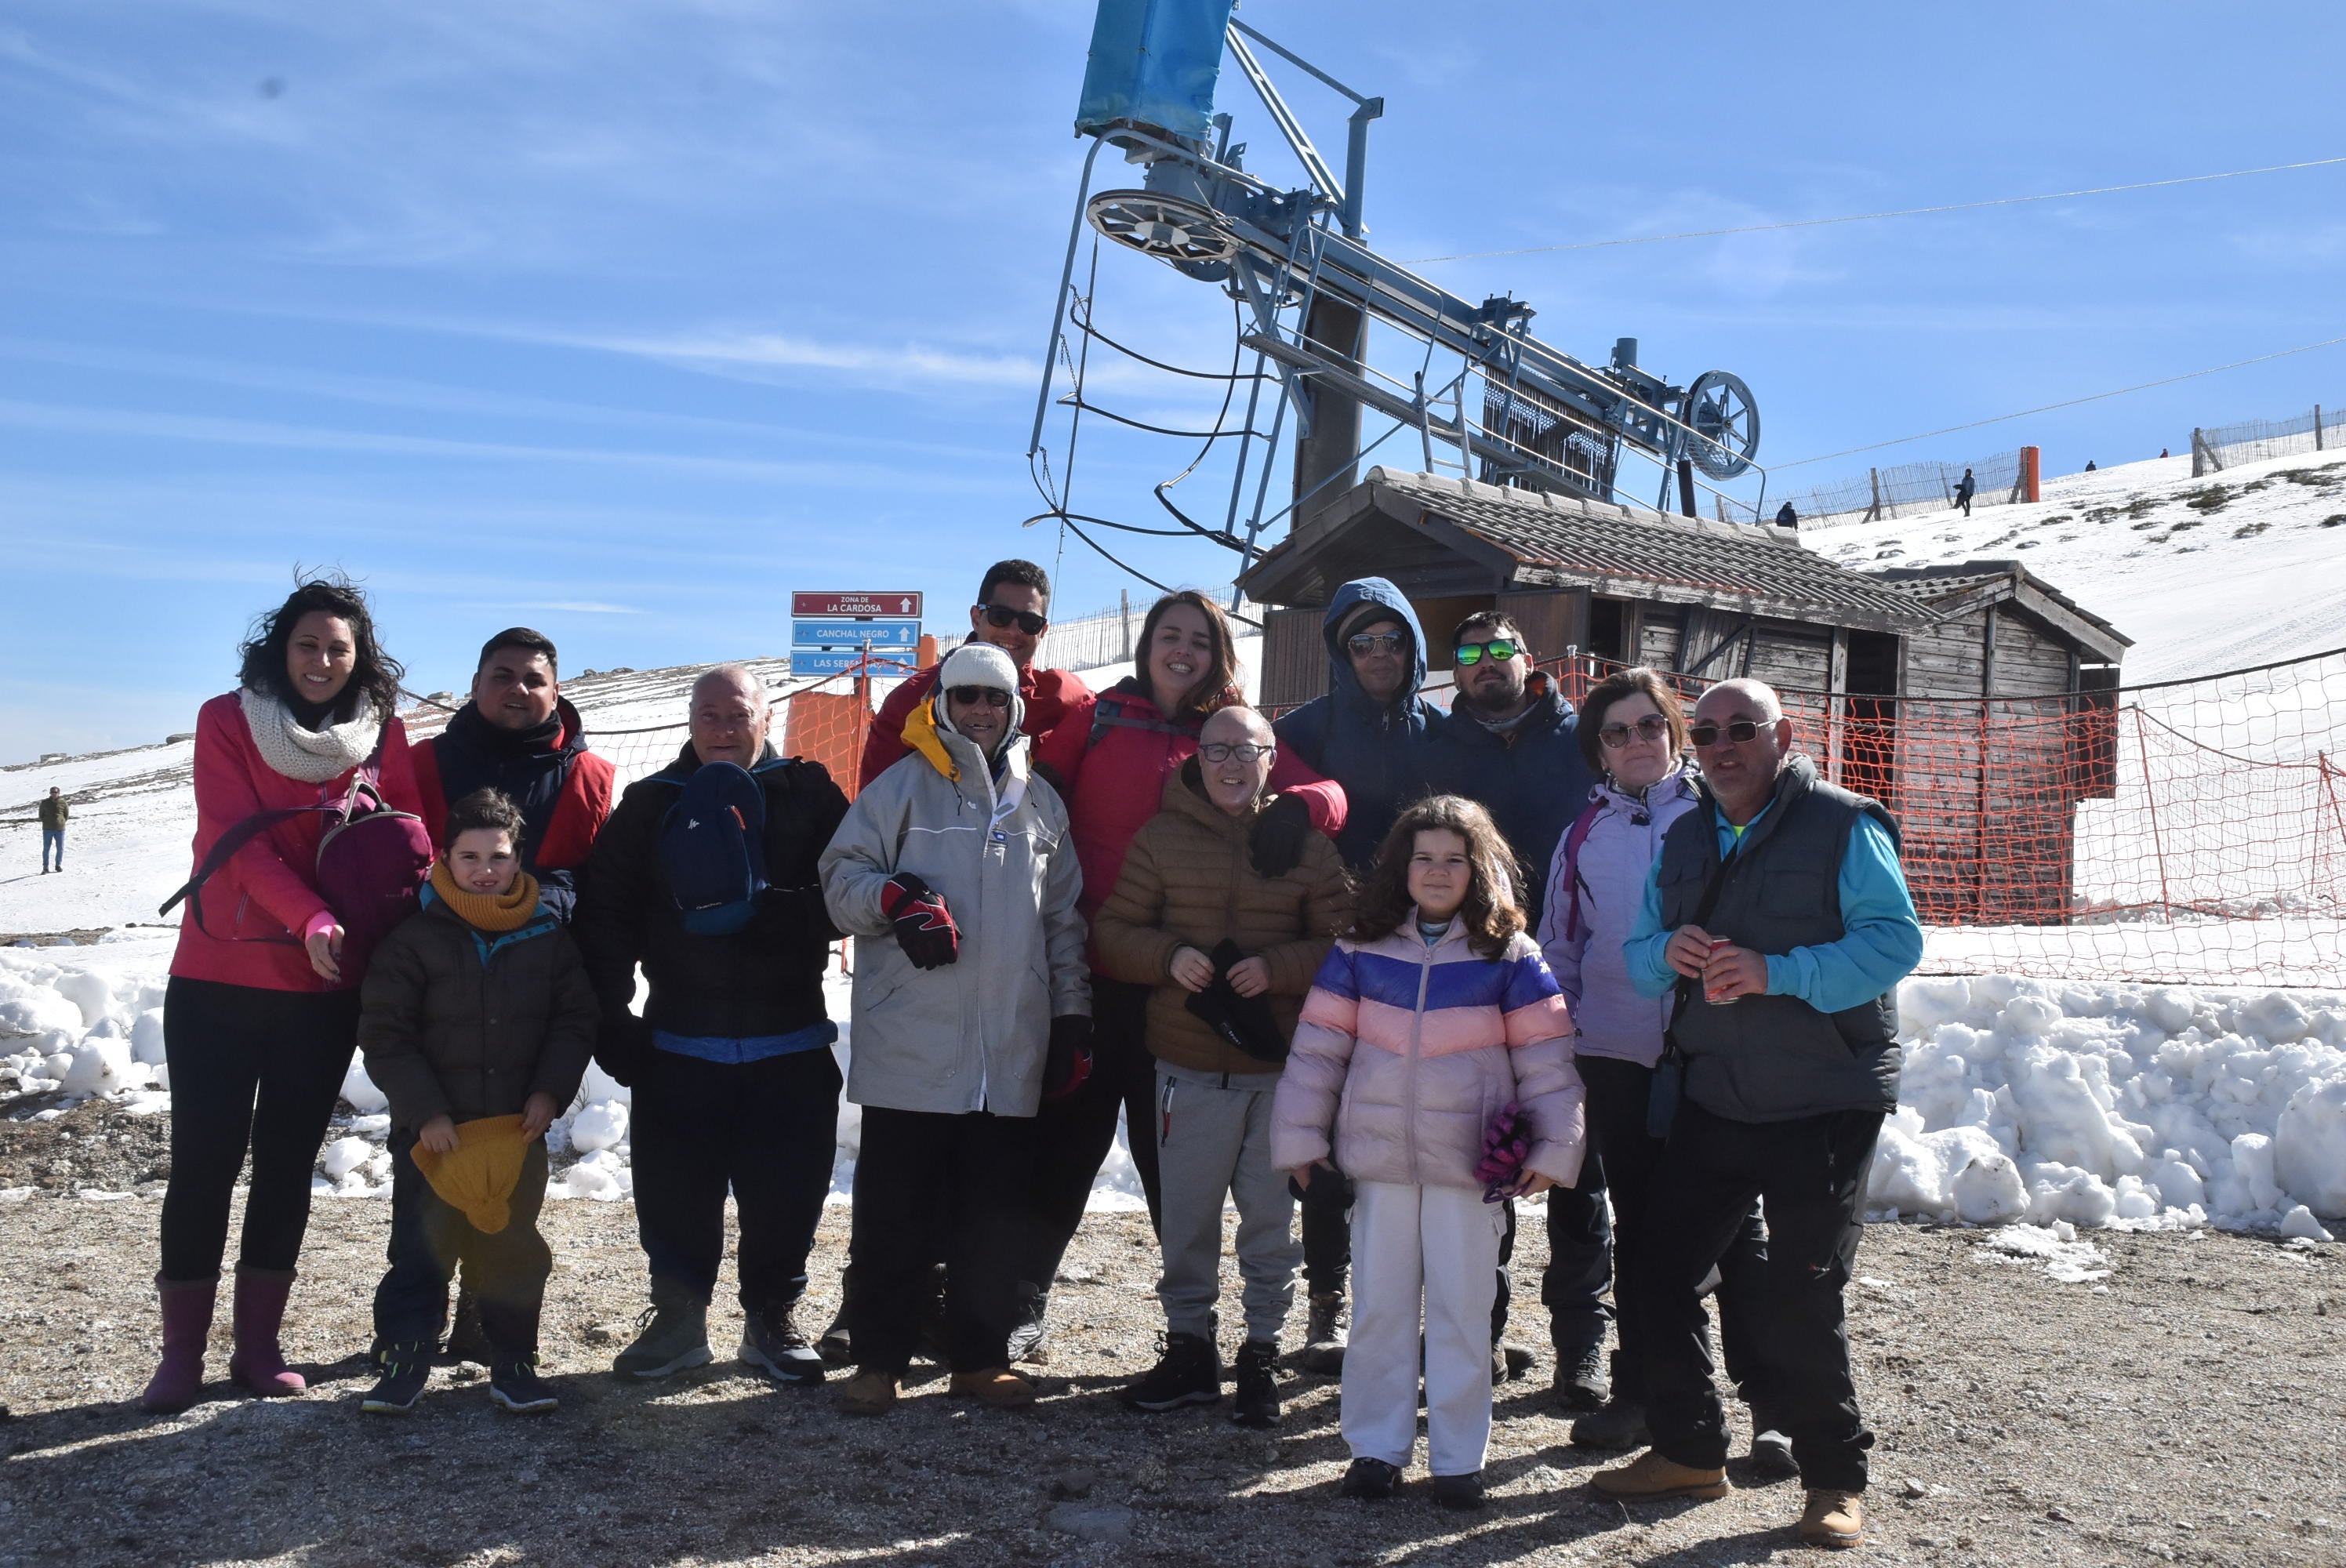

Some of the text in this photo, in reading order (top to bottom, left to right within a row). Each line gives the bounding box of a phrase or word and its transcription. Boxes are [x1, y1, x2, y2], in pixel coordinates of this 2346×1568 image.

[827, 604, 882, 612] LA CARDOSA
[816, 630, 890, 638] CANCHAL NEGRO
